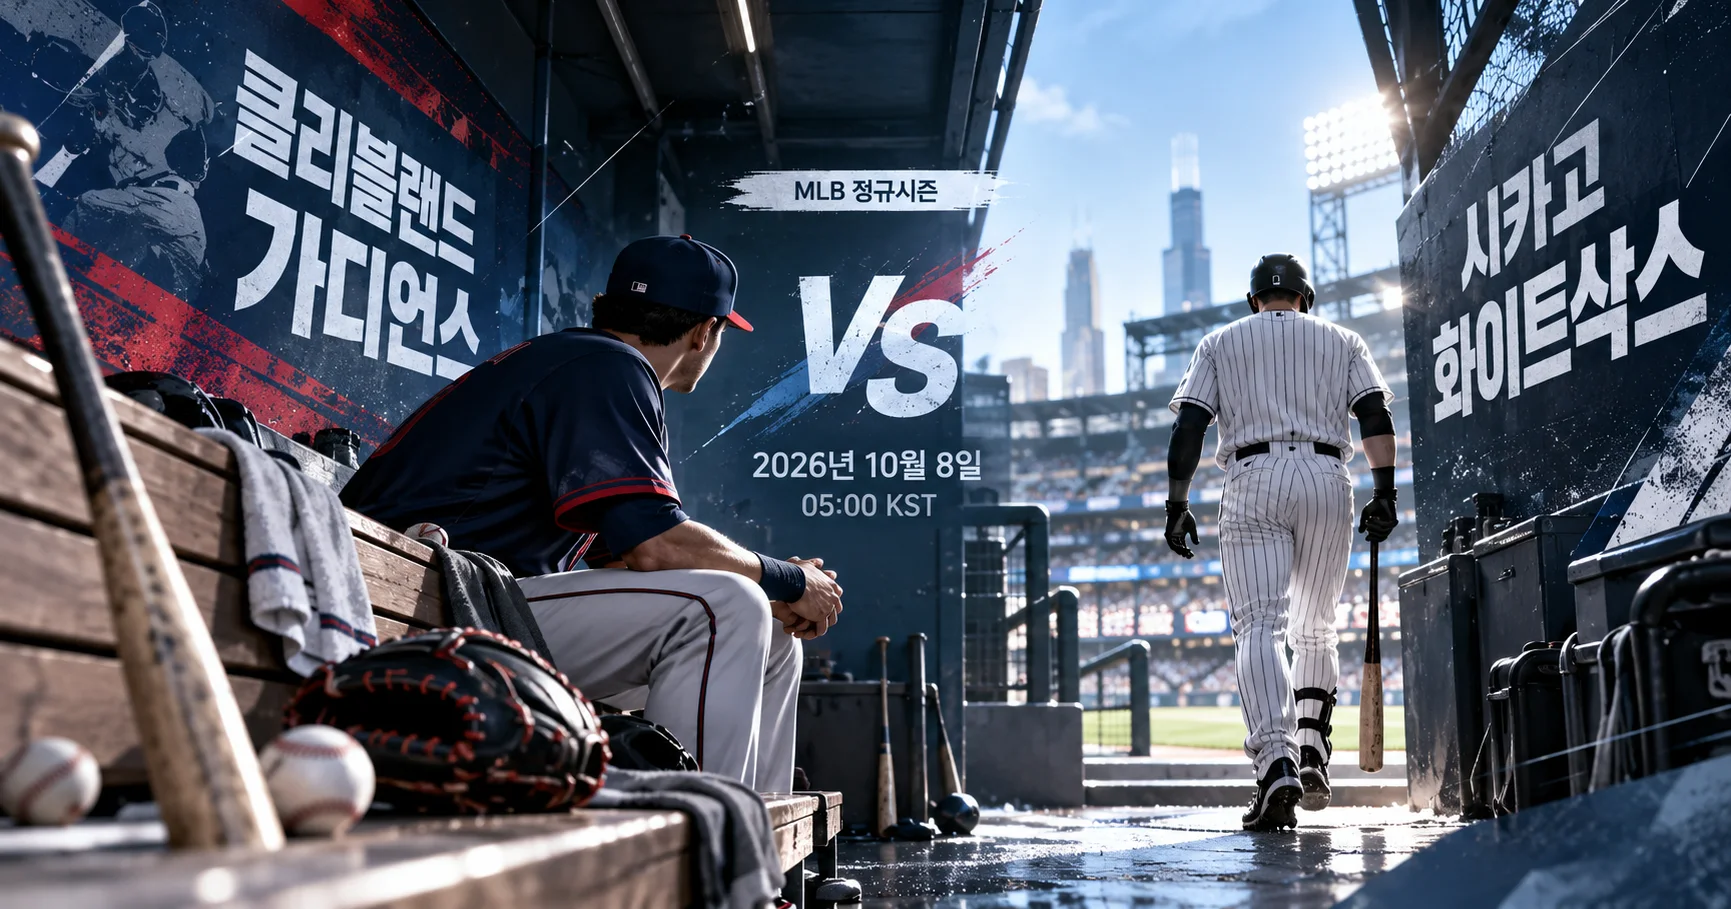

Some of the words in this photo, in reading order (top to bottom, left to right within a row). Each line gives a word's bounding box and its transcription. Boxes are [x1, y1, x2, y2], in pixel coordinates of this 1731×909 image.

[233, 48, 476, 275] 클리블랜드
[1461, 118, 1605, 292] 시카고
[234, 188, 480, 381] 가디언스
[1432, 199, 1707, 423] 화이트삭스
